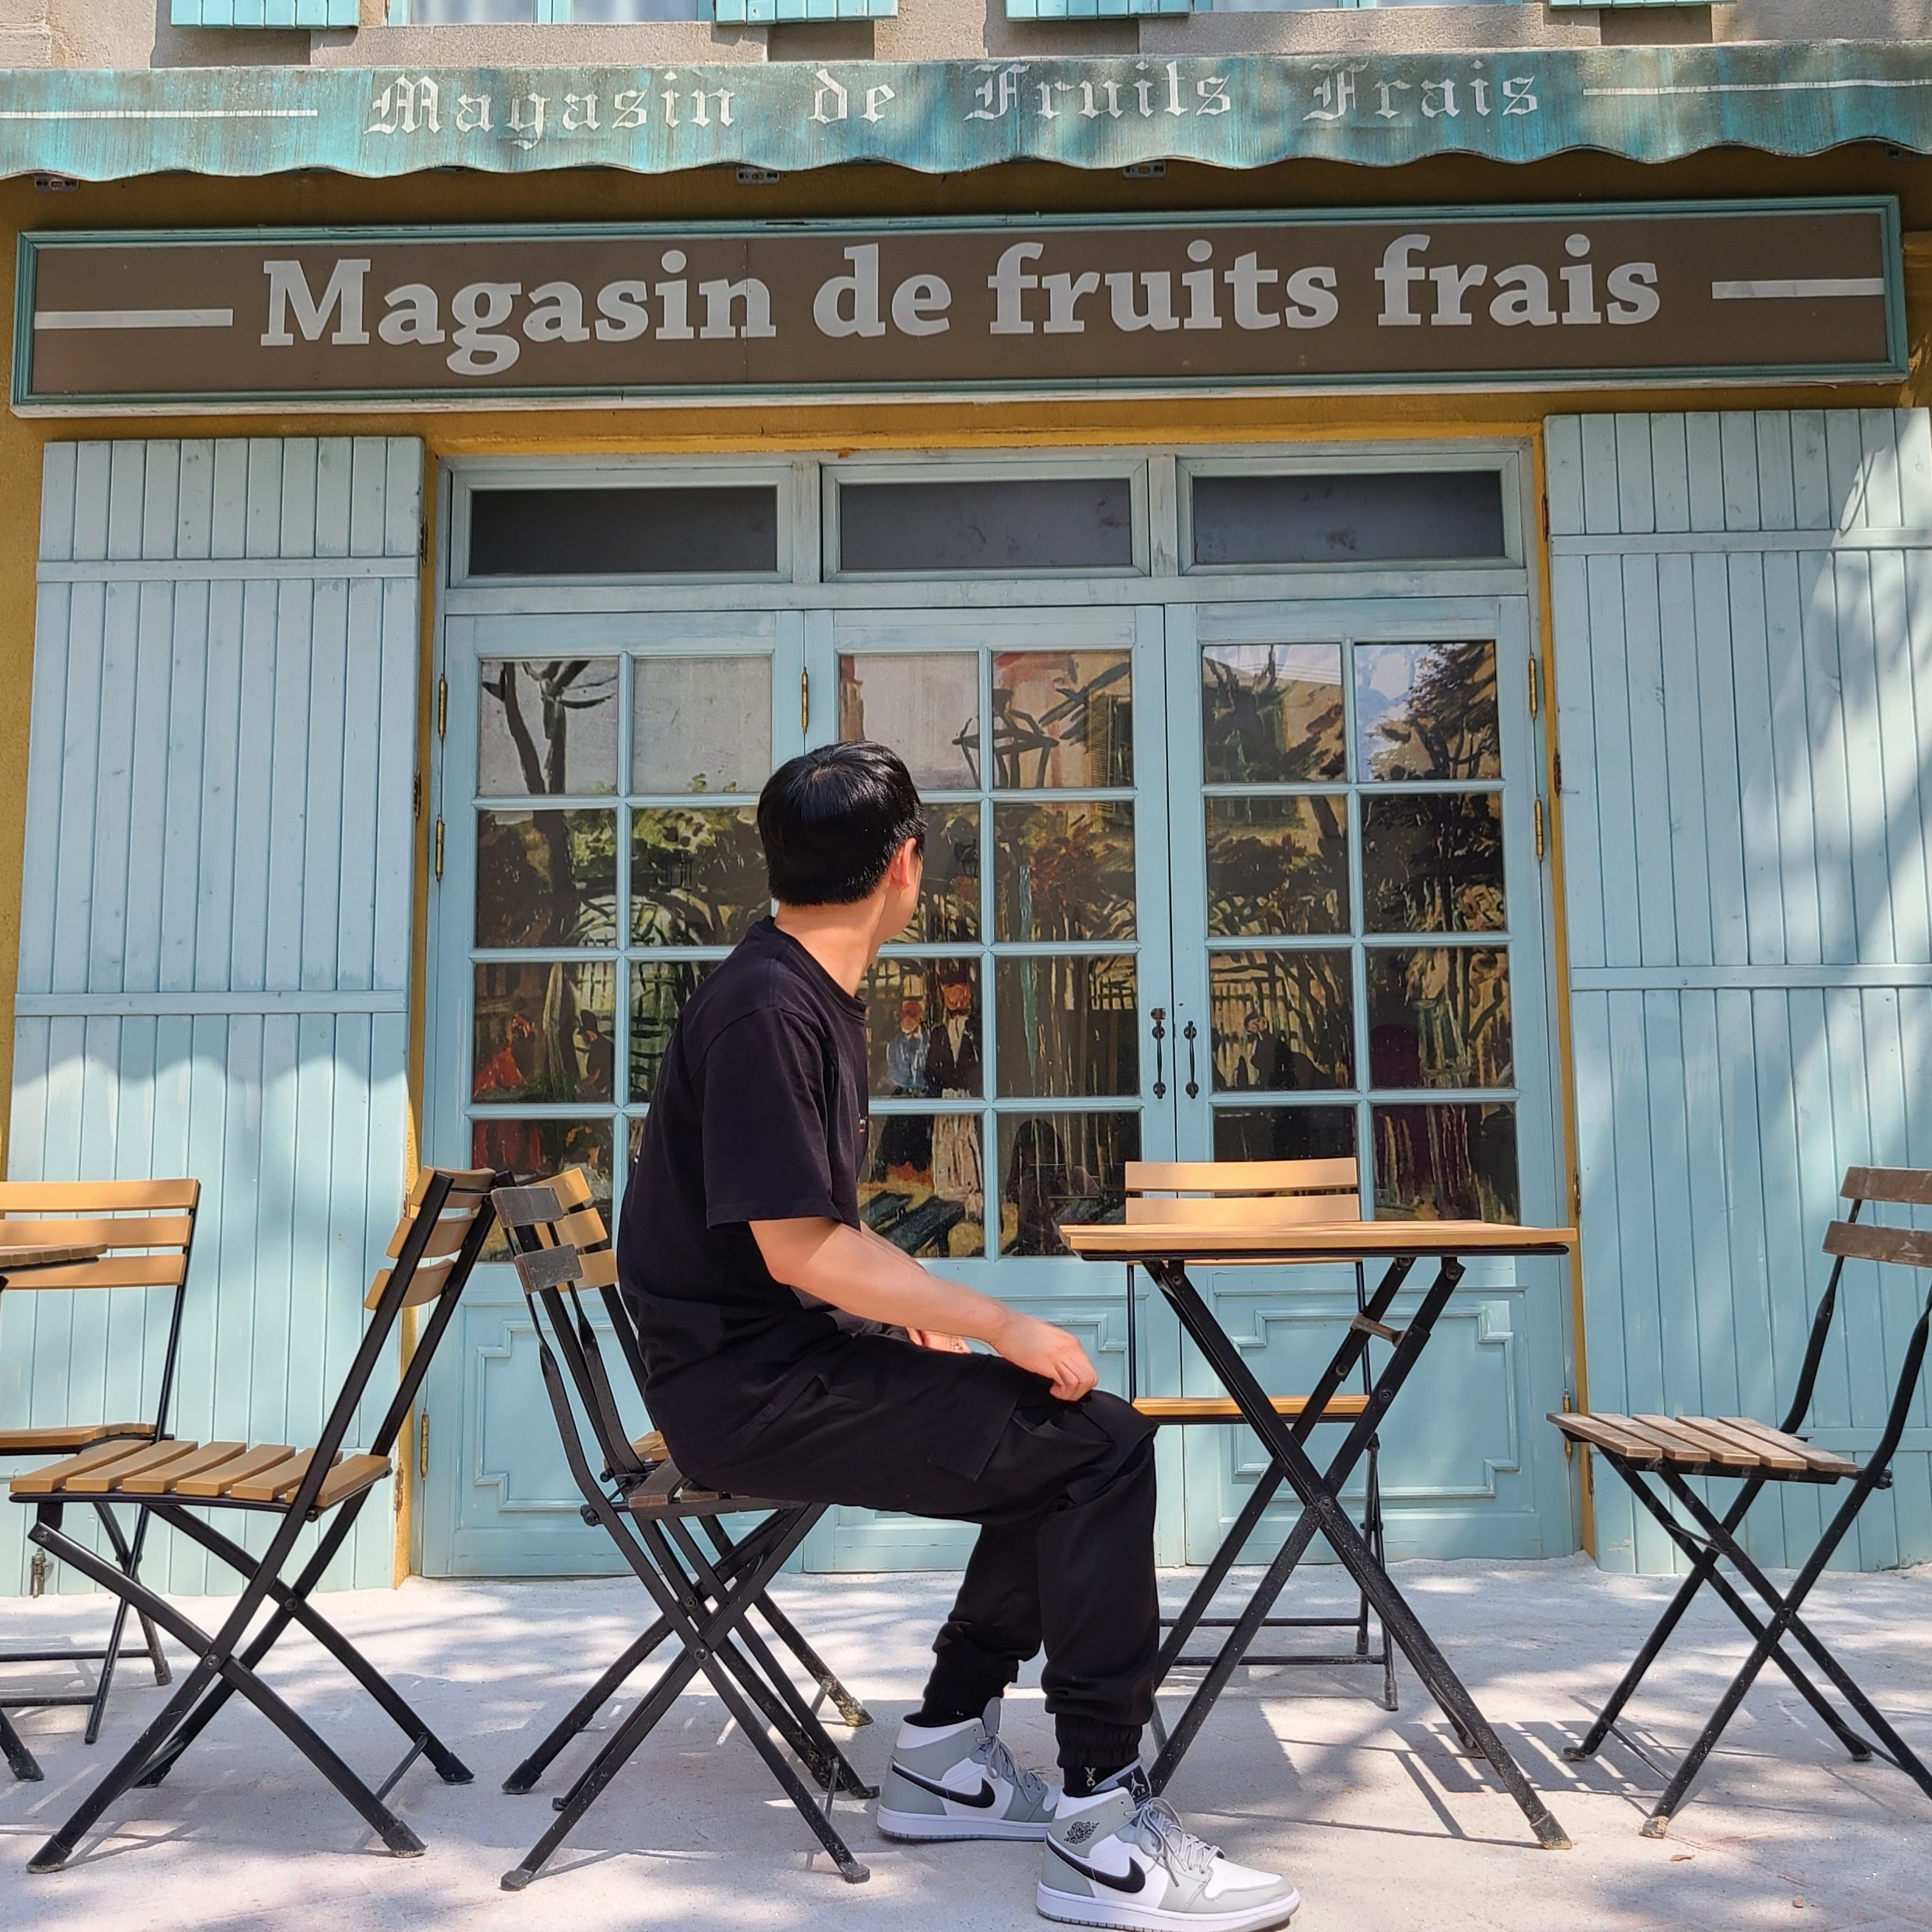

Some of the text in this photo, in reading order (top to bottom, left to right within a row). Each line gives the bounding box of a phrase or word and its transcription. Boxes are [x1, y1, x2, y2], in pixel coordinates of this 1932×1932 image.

[364, 60, 1539, 151] Magasin de Fruits Frais
[260, 234, 1660, 375] Magasin de fruits frais
